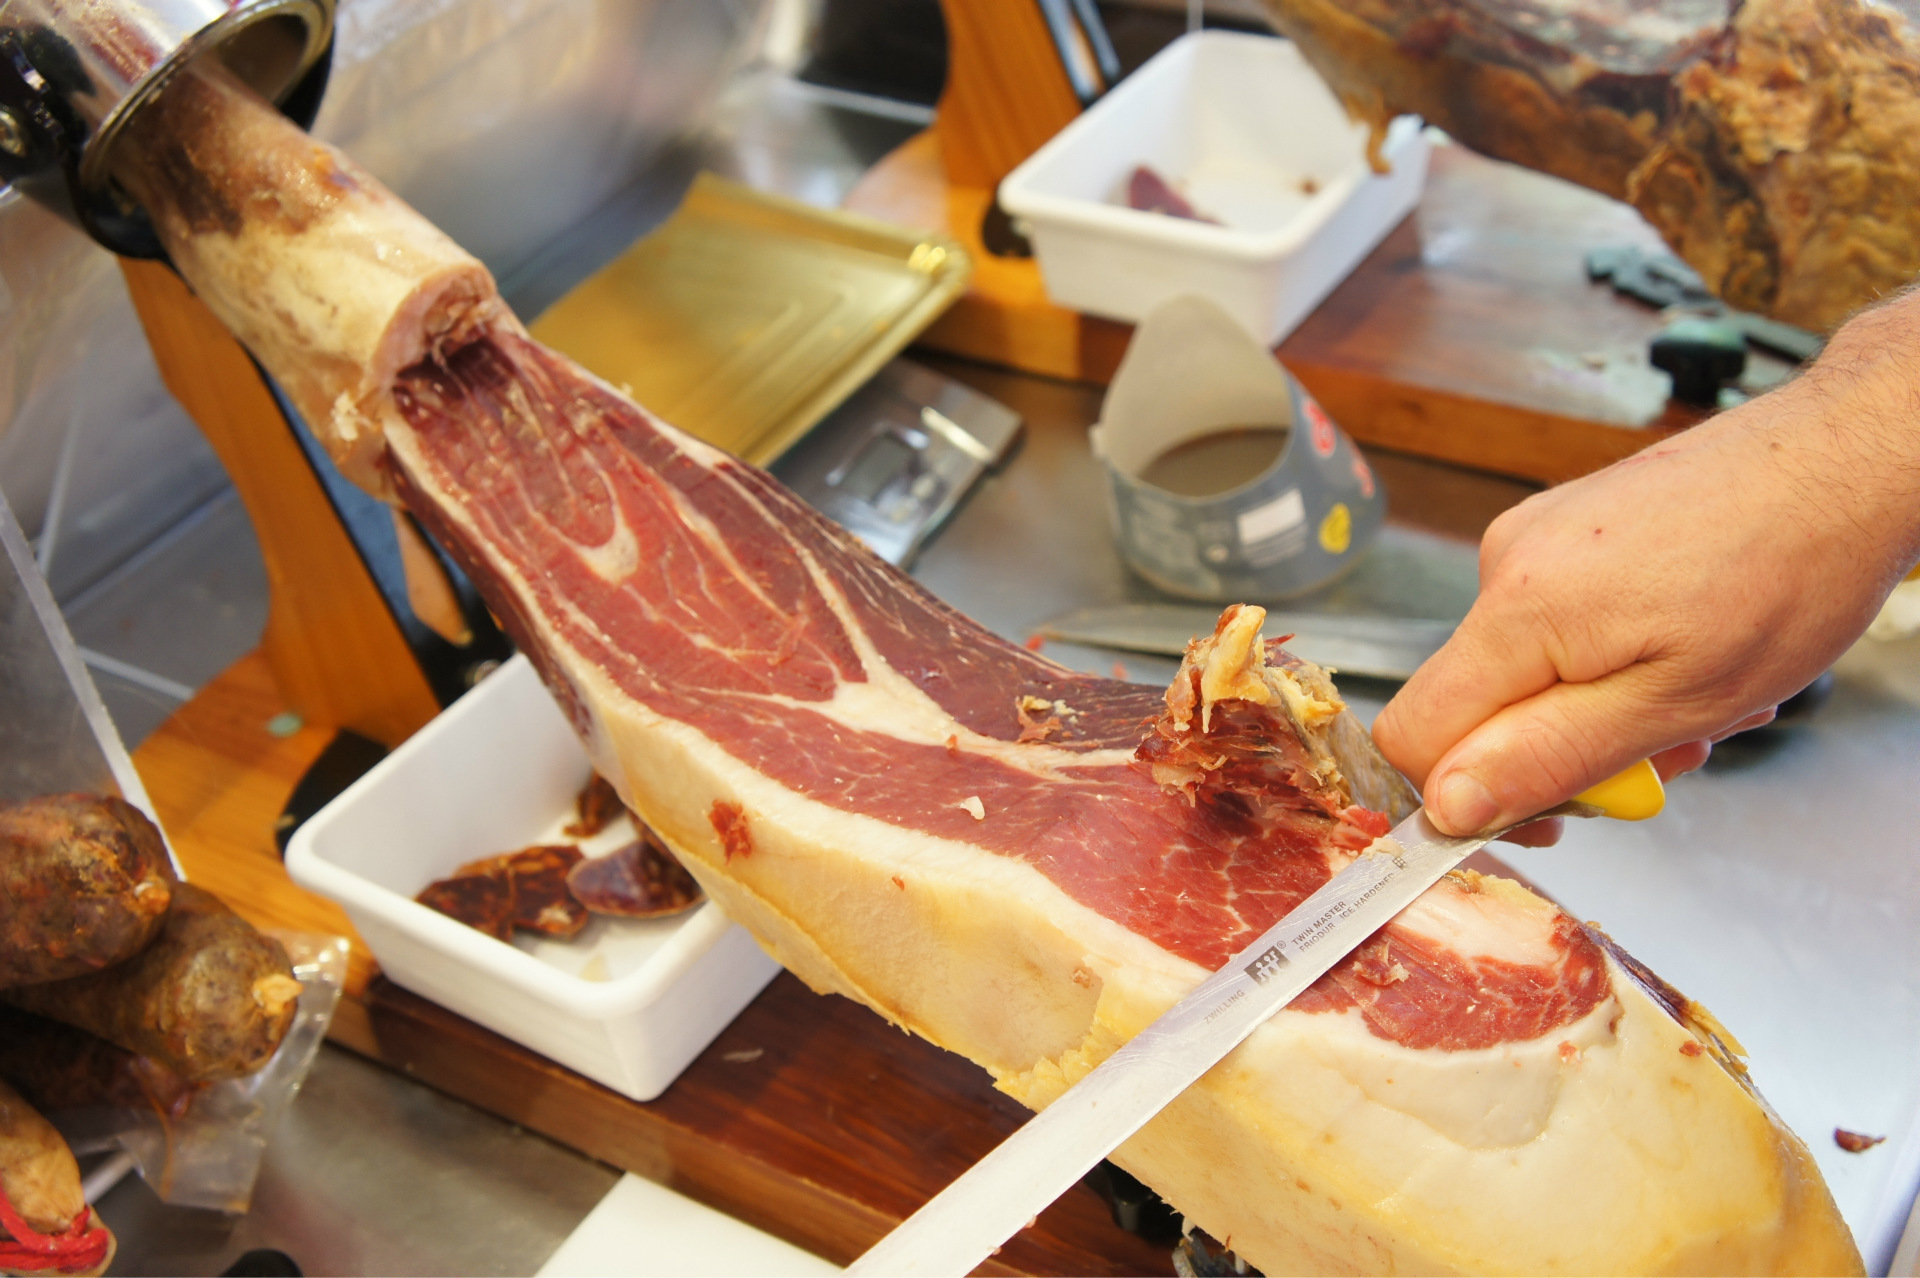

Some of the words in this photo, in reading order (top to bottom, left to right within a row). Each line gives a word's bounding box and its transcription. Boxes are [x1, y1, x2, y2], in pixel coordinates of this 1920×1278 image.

[1291, 924, 1314, 946] TWIN
[1313, 901, 1347, 929] MASTER
[1299, 923, 1335, 953] FRIODUR
[1339, 906, 1355, 921] ICE
[1204, 989, 1245, 1024] ZWILLING
